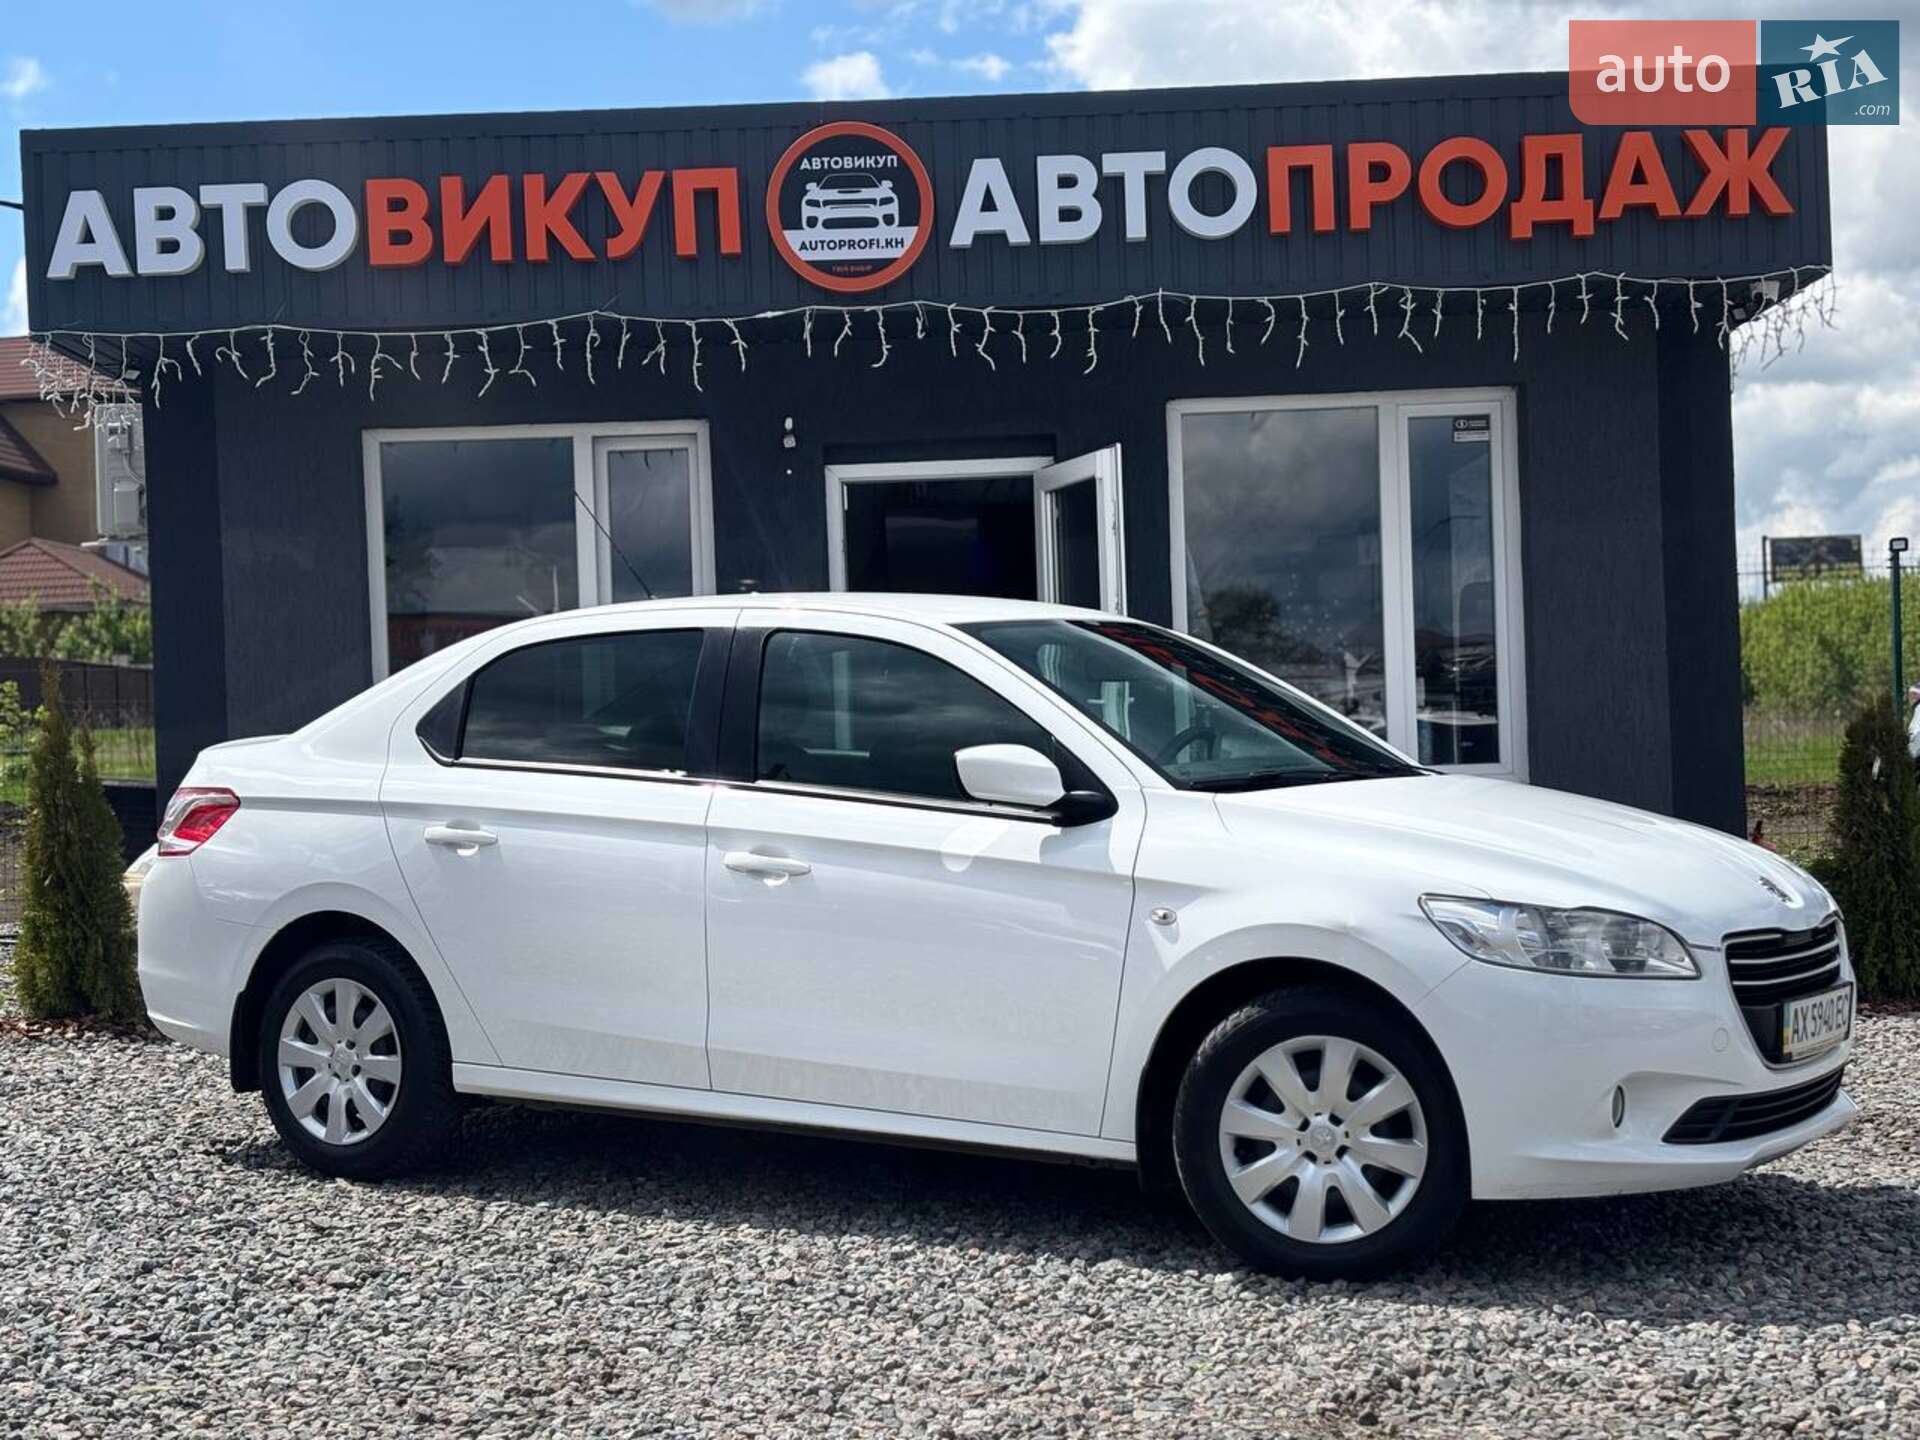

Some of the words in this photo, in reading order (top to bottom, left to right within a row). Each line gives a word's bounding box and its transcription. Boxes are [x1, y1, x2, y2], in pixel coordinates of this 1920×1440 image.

[799, 155, 898, 170] АВТОВИКУП
[949, 127, 1794, 249] АВТОПРОДАЖ
[46, 167, 744, 281] АВТОВИКУП
[799, 237, 905, 252] AUTOPROFI.KH
[1792, 1006, 1809, 1041] AX
